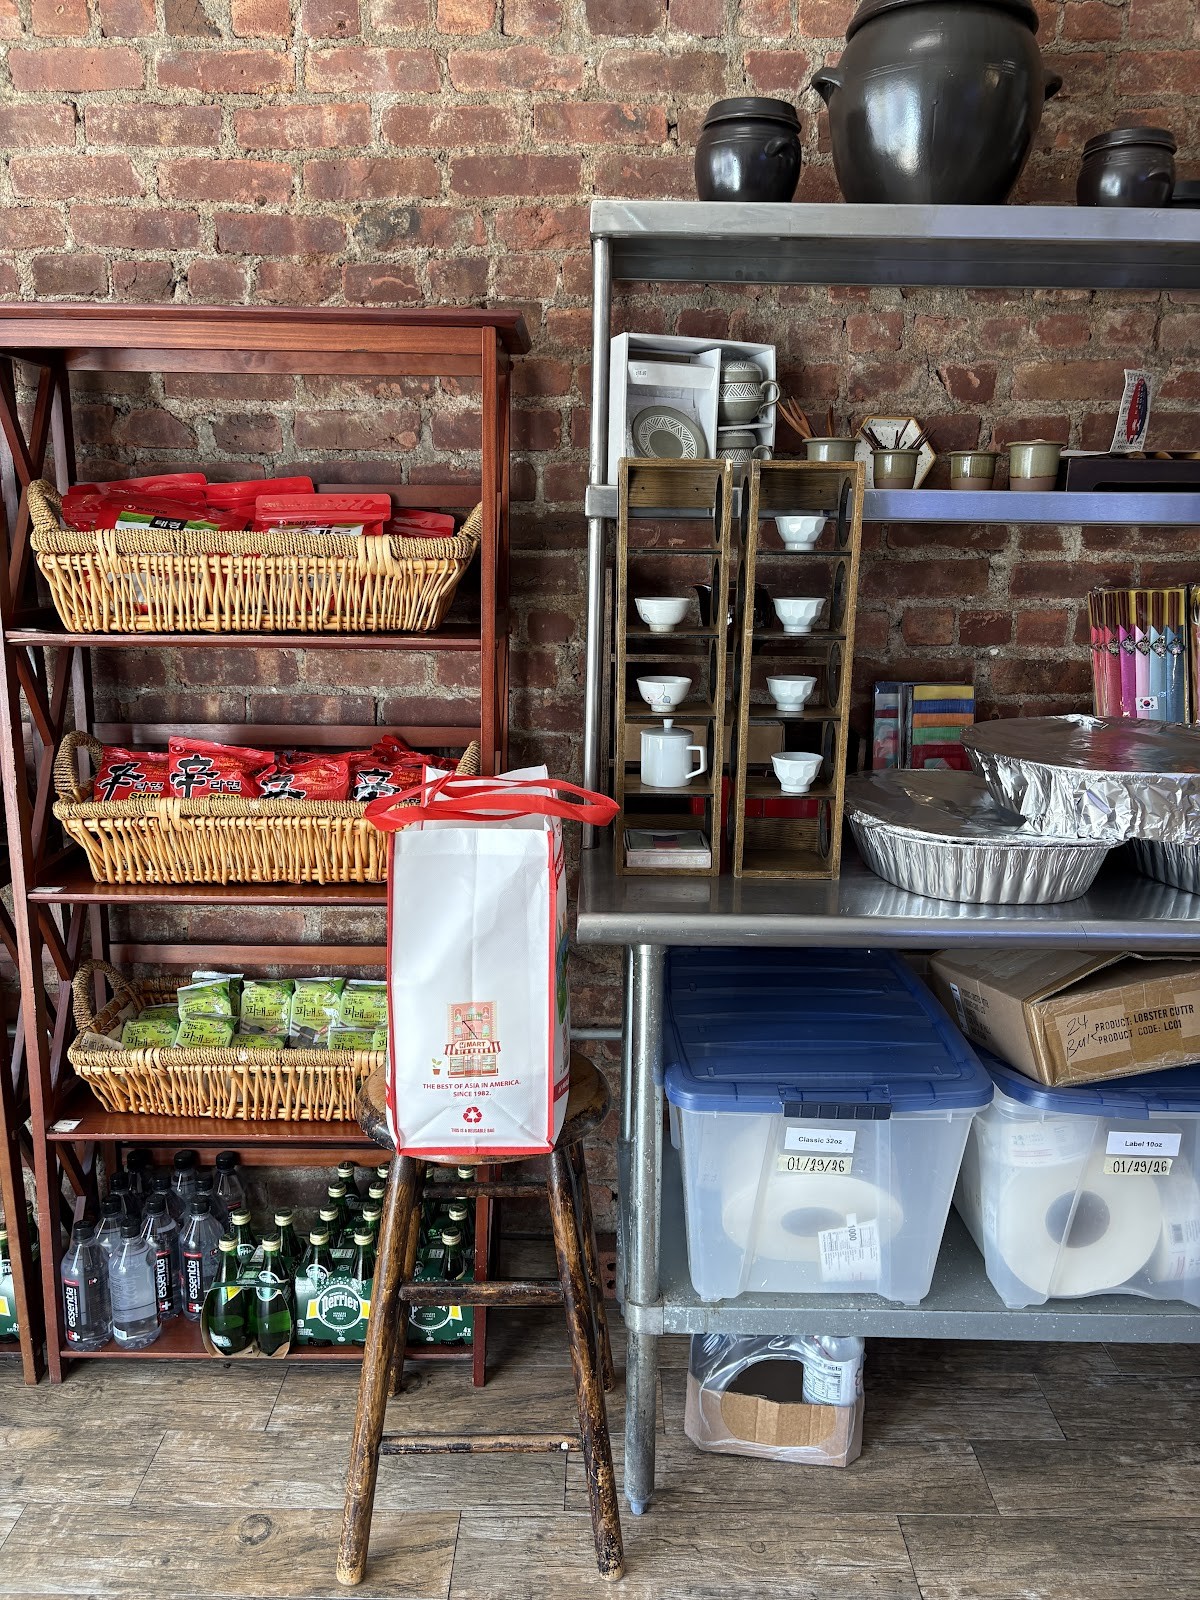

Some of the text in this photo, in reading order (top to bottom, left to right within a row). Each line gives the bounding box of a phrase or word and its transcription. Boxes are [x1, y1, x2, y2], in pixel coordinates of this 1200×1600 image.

[134, 781, 164, 792] 라면
[209, 779, 242, 792] 라면
[129, 792, 160, 800] SHIN
[1066, 1014, 1089, 1037] 24
[1095, 1004, 1195, 1032] PRODUCT: LOBSTER CUTTR
[1098, 1029, 1133, 1045] PRODUCT
[1138, 1024, 1161, 1036] CODE:
[489, 1079, 522, 1088] AMERICA.
[798, 1136, 843, 1145] Classic 32oz
[1125, 1140, 1145, 1148] Label
[787, 1156, 845, 1173] 01/29/26
[1112, 1159, 1168, 1174] 01/29/26
[847, 1225, 857, 1241] 1000
[186, 1260, 198, 1300] essentia
[65, 1286, 76, 1328] essentia
